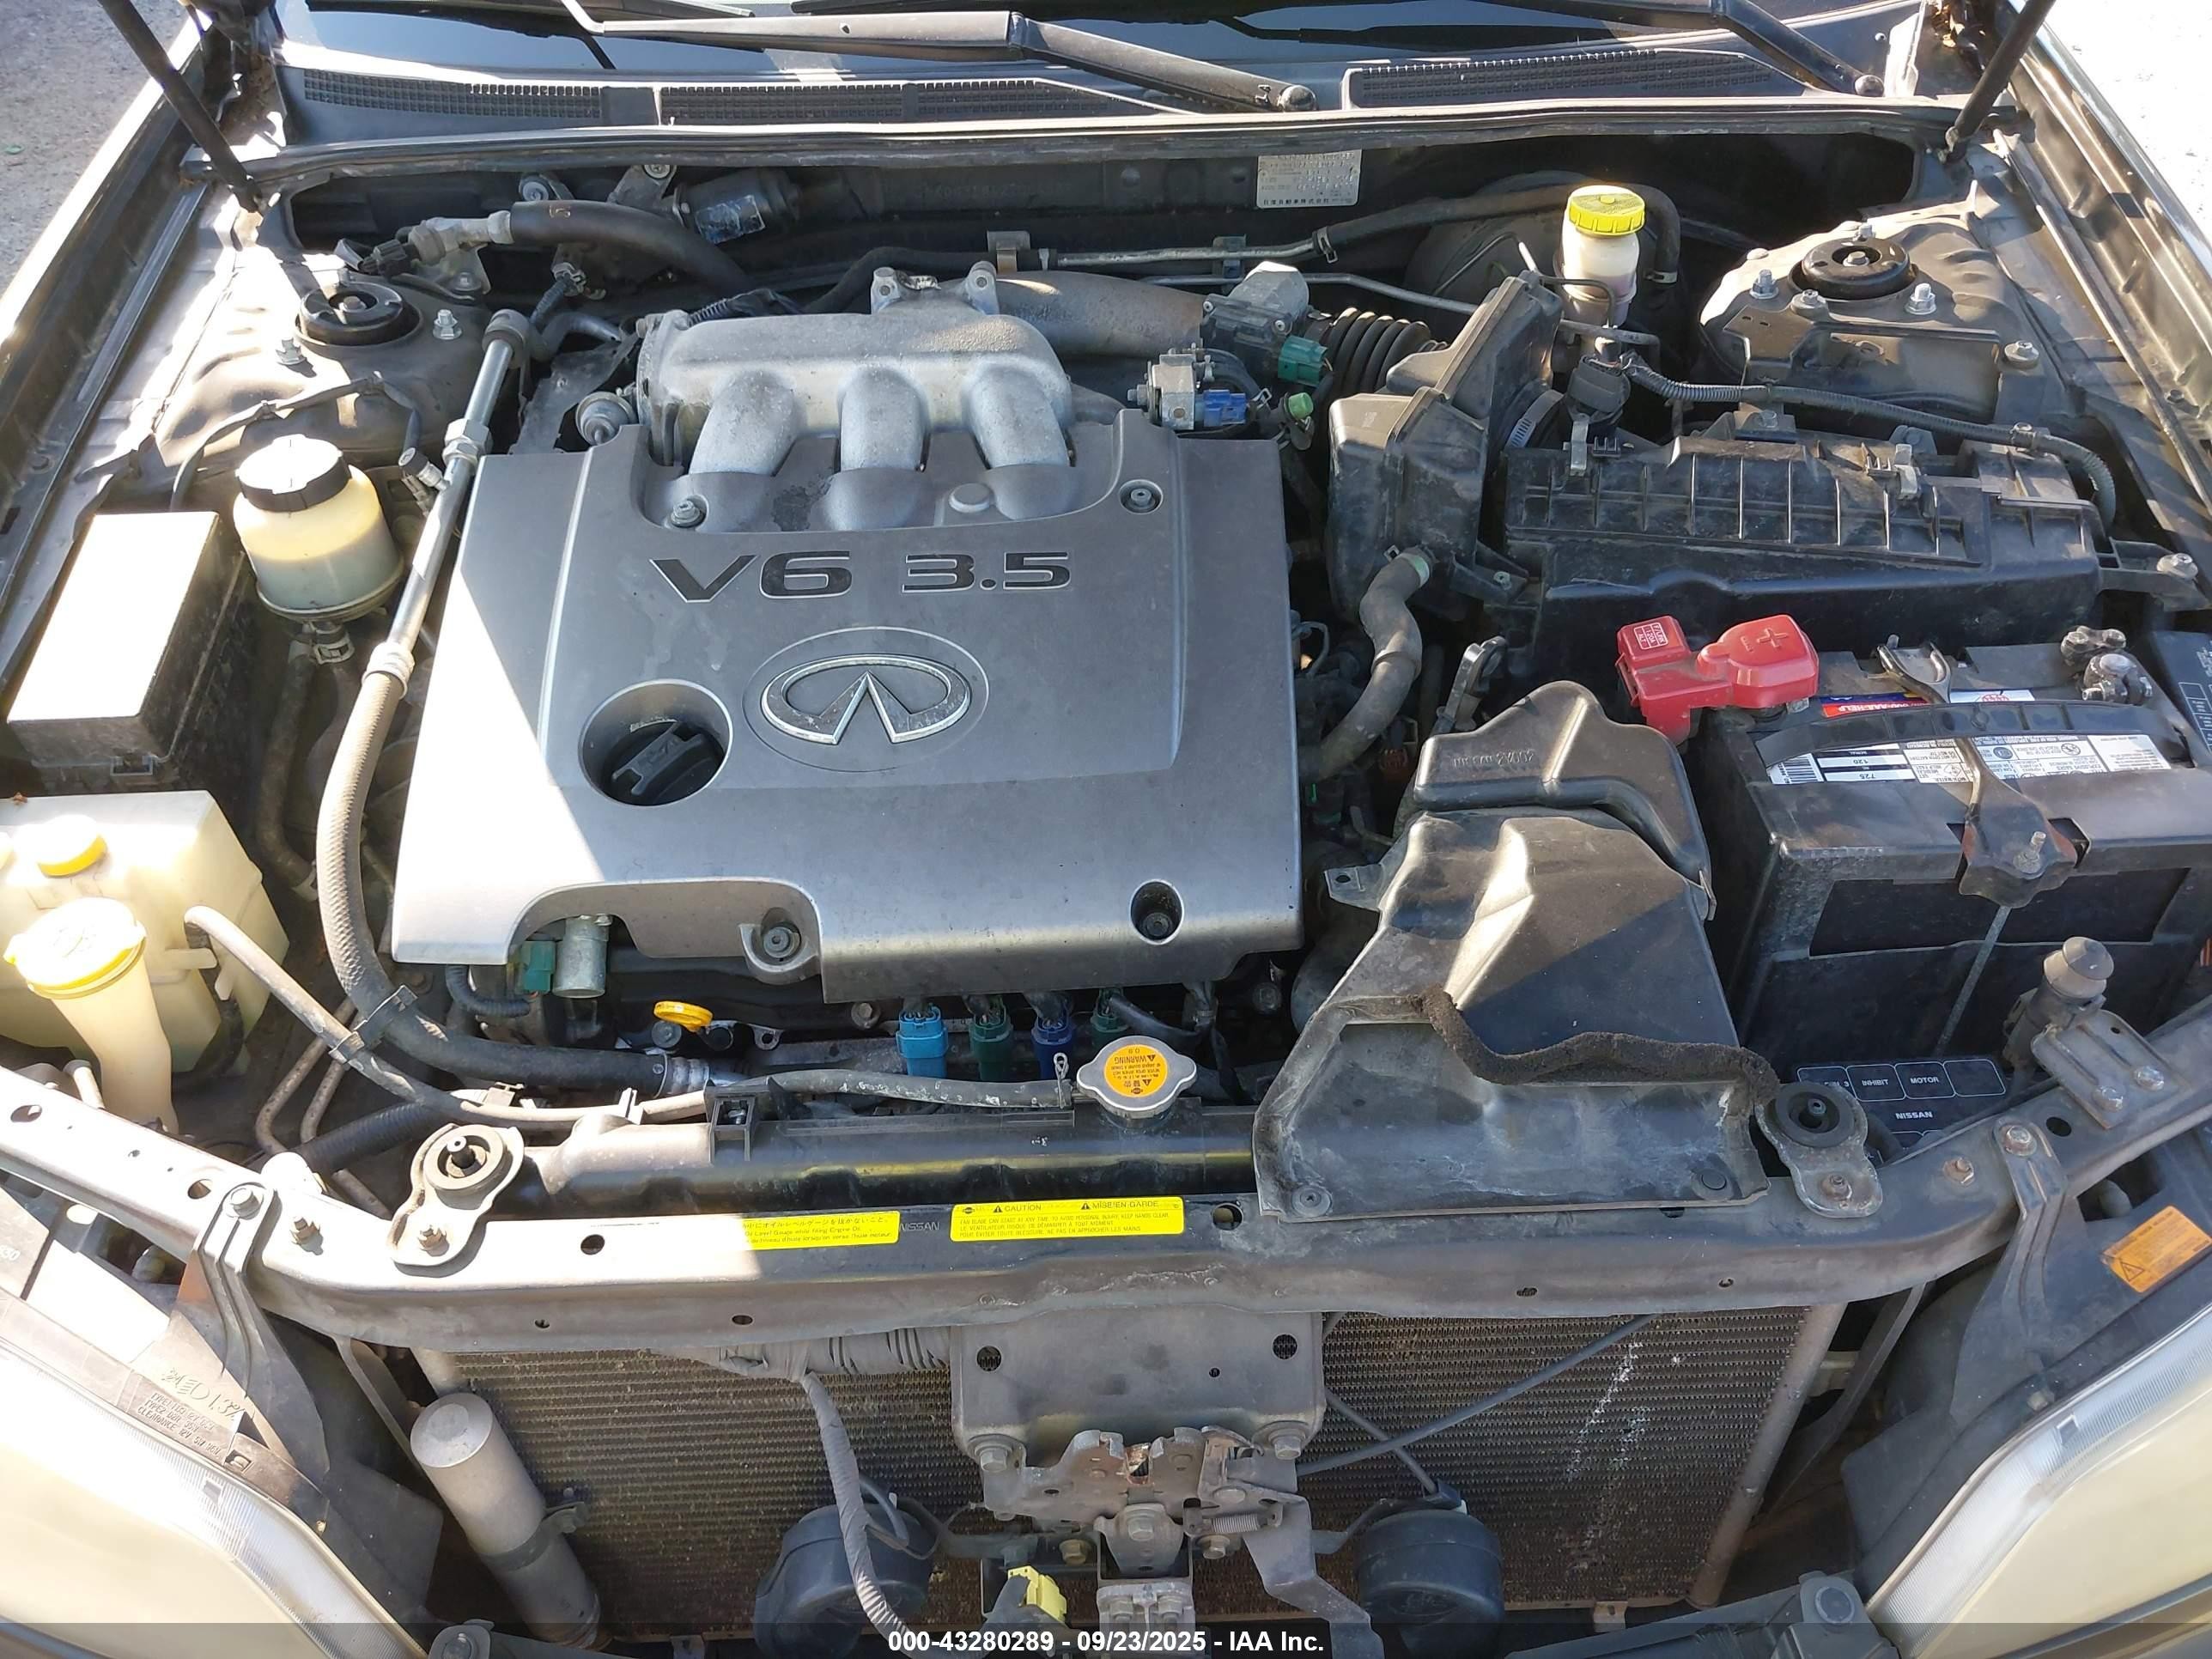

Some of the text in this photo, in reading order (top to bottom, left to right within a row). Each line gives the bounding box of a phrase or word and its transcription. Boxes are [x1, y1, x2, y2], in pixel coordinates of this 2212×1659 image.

[648, 550, 1072, 603] V6 3.5
[1114, 1054, 1146, 1064] WARNING
[1862, 1078, 1889, 1086] INHIBIT
[1895, 1110, 1933, 1120] NISSAN
[899, 1221, 940, 1231] NISSAN
[151, 1393, 173, 1408] TYPE1
[145, 1400, 167, 1415] TYPE2
[137, 1407, 177, 1431] CLEARANCE
[179, 1428, 192, 1440] 12V
